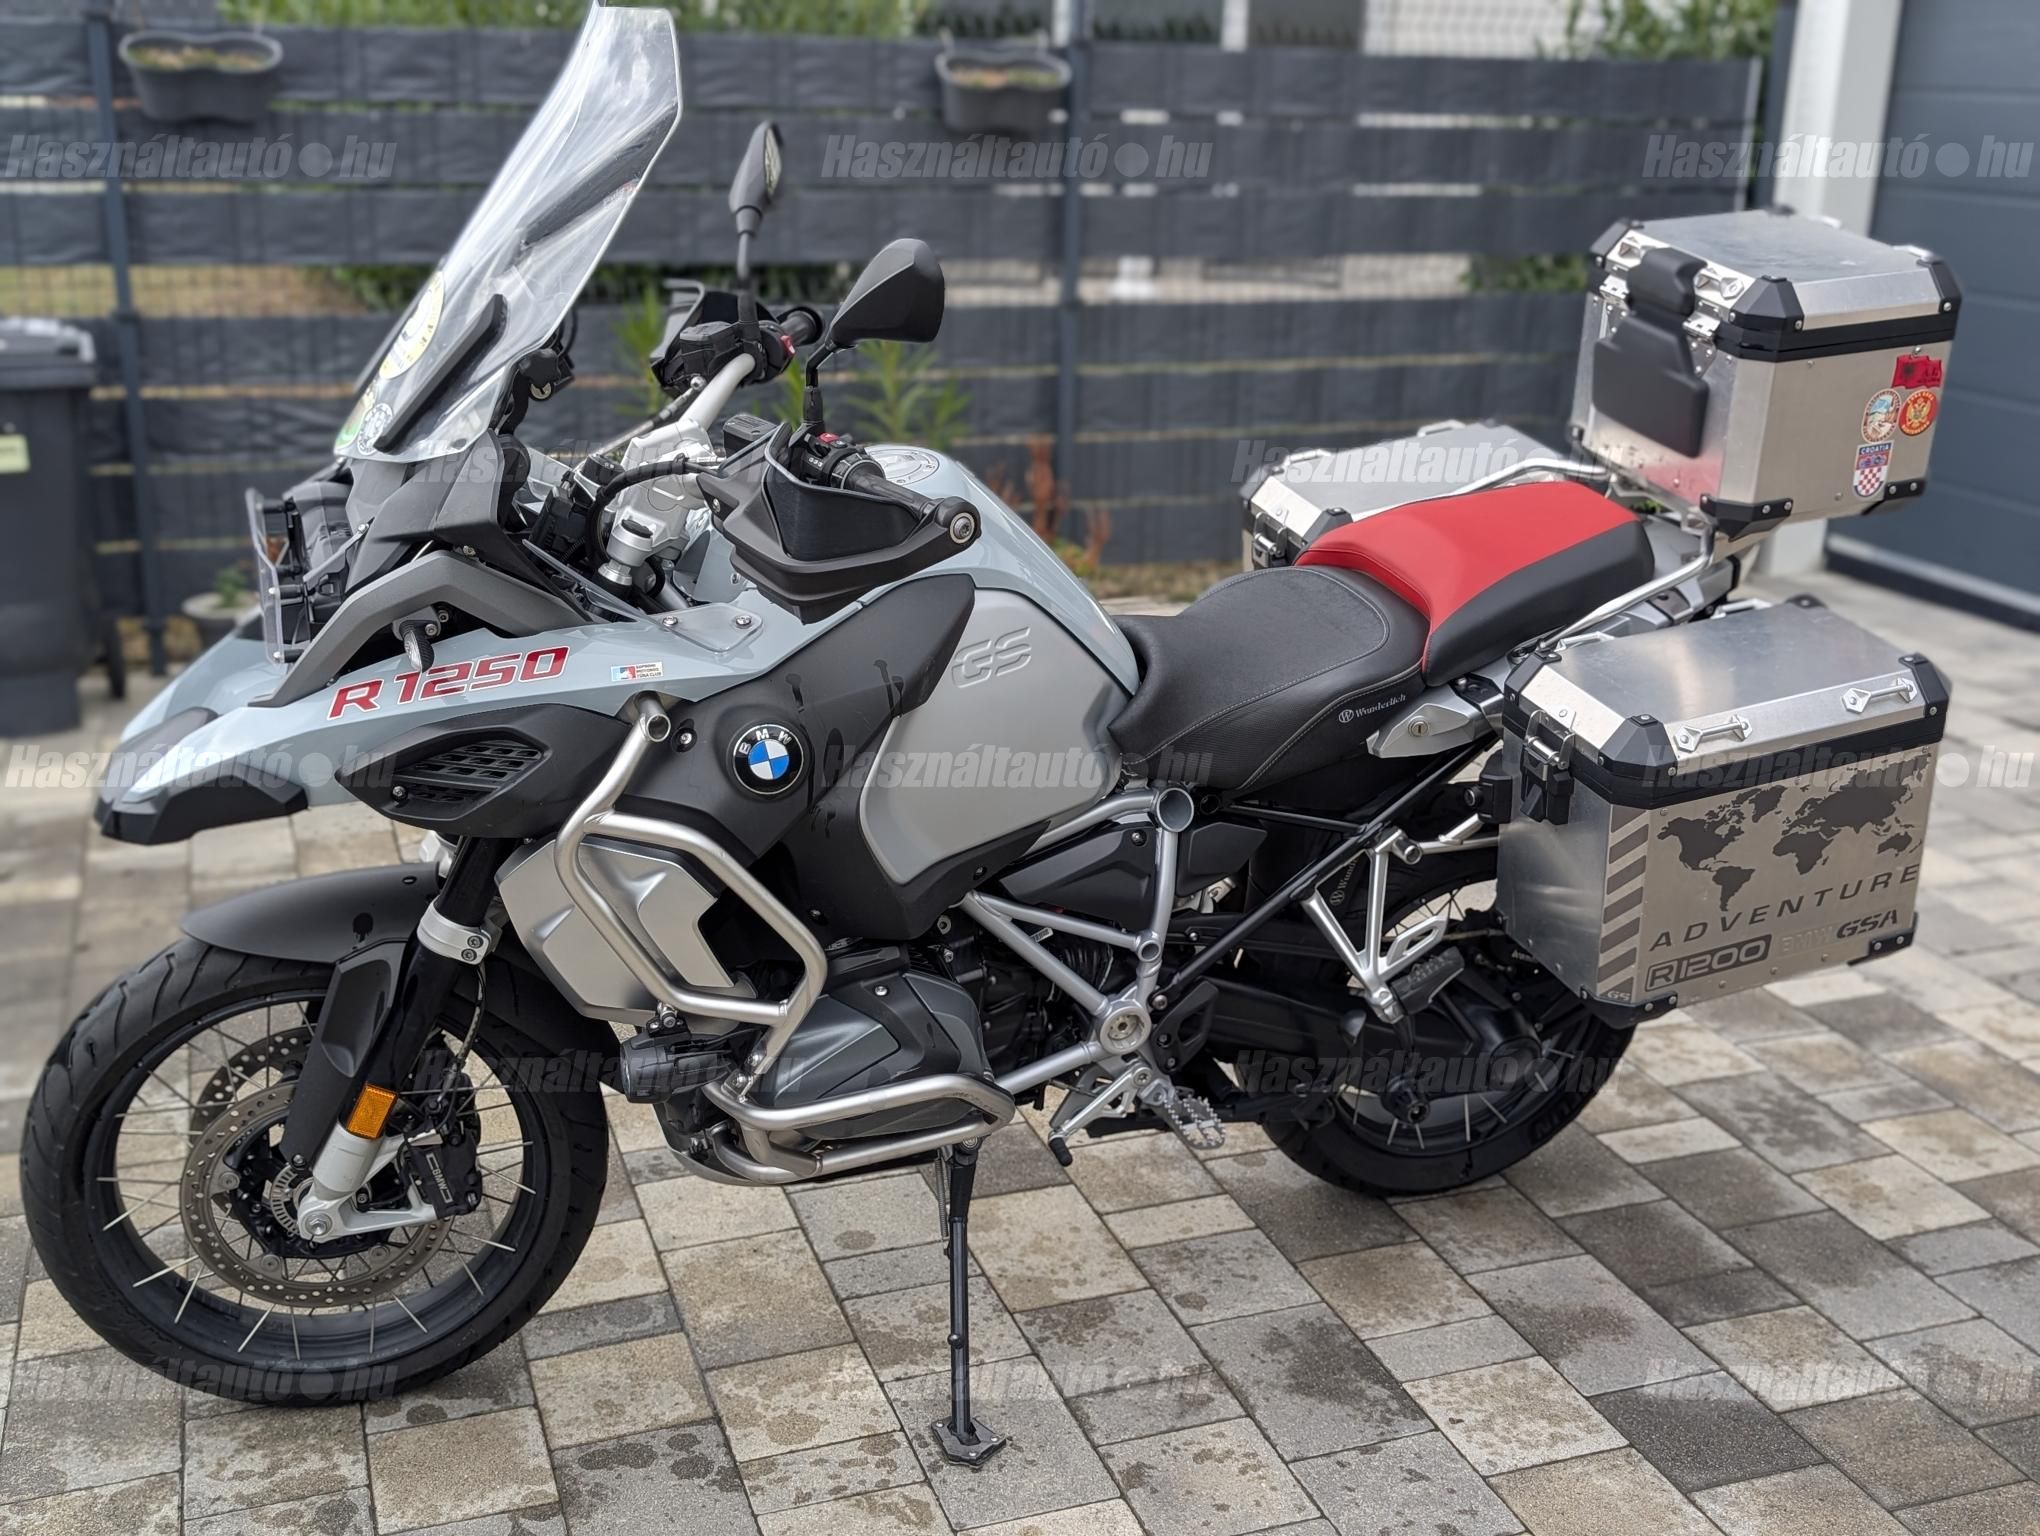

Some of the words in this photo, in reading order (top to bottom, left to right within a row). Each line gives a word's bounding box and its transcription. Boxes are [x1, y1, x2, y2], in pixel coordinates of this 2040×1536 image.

[1860, 443, 1890, 455] CROATIA
[952, 626, 1032, 689] GS
[327, 679, 384, 720] R
[394, 646, 571, 705] 1250
[1355, 693, 1406, 718] Wunderlich
[739, 728, 792, 755] BMW
[1649, 864, 1920, 951] ADVENTURE
[1649, 938, 1767, 988] R1200
[1836, 909, 1898, 939] GSA
[1607, 990, 1631, 1001] GS
